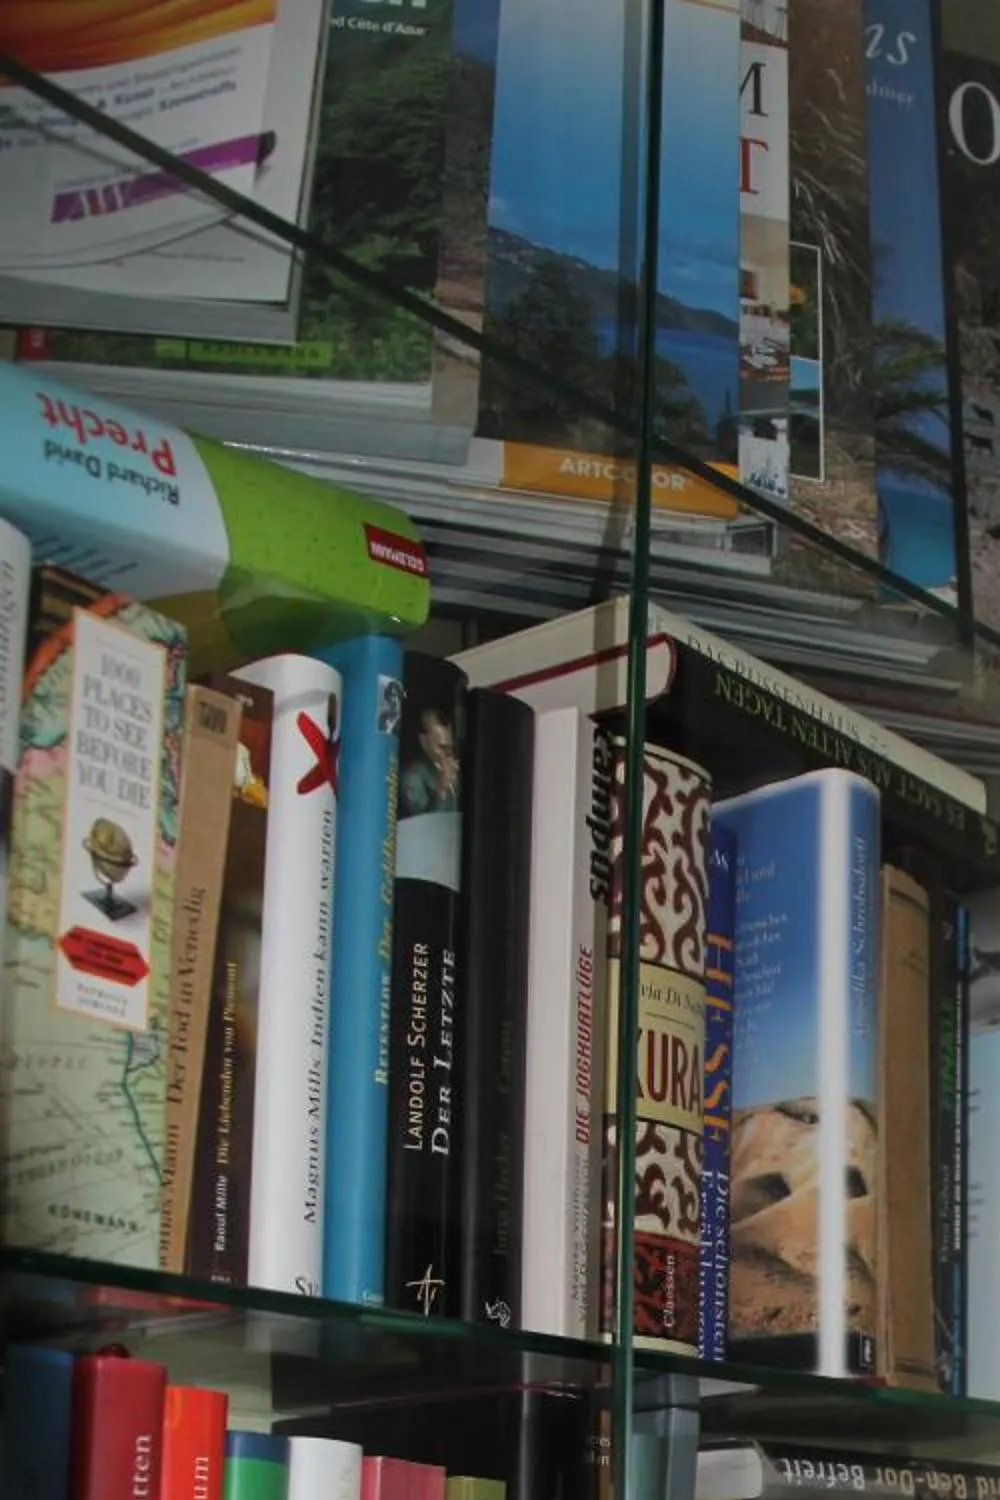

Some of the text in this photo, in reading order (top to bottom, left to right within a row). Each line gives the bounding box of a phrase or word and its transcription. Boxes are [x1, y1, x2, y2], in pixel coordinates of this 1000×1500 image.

[35, 392, 177, 477] Precht
[42, 439, 179, 506] Richard David
[559, 457, 686, 491] ARTCOOR
[402, 942, 430, 1152] LANDOLF SCHERZER
[430, 948, 456, 1157] DER LETZTE
[574, 1109, 591, 1145] DIE
[780, 1457, 866, 1490] Befreit
